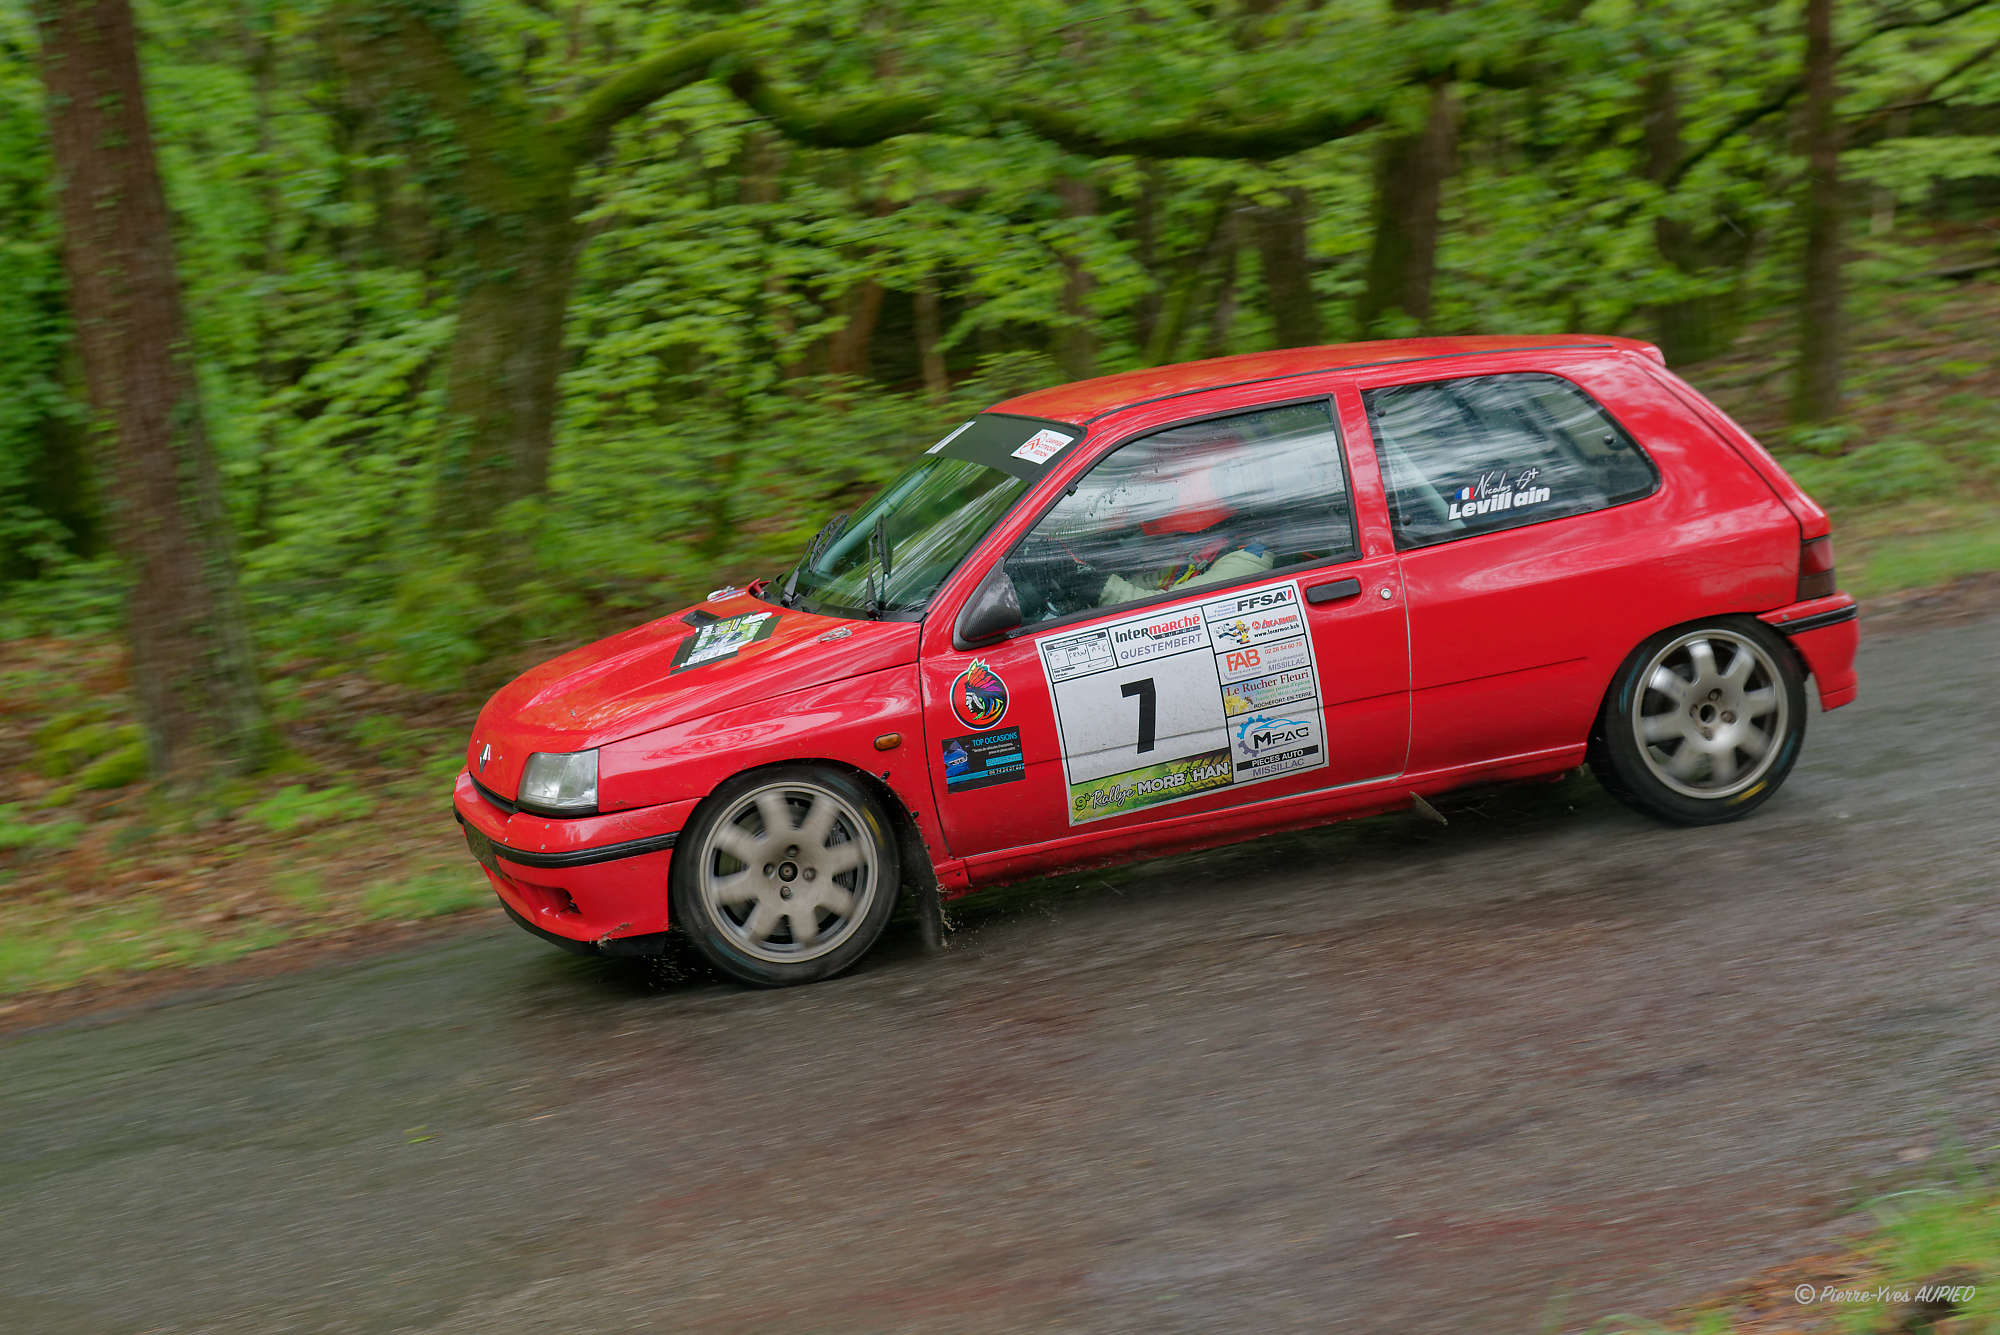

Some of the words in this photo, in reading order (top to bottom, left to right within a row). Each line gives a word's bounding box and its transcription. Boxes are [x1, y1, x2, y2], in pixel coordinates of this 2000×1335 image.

[1474, 470, 1512, 498] Nicolas
[1237, 592, 1287, 611] FFSA
[1114, 613, 1201, 643] Intermarché
[1120, 633, 1202, 660] QUESTEMBERT
[1226, 649, 1261, 672] FAB
[1268, 658, 1306, 672] MISSILLAC
[1226, 687, 1240, 697] Le
[1242, 678, 1278, 693] Rucher
[1280, 669, 1309, 684] Fleuri
[1120, 677, 1157, 755] 7
[973, 738, 984, 747] TOP
[985, 731, 1018, 744] OCCASIONS
[1253, 727, 1309, 749] MPAC
[1252, 754, 1281, 767] PIECES
[1282, 749, 1304, 761] AUTO
[1252, 758, 1305, 777] MISSILLAC
[1091, 787, 1136, 809] Rallye
